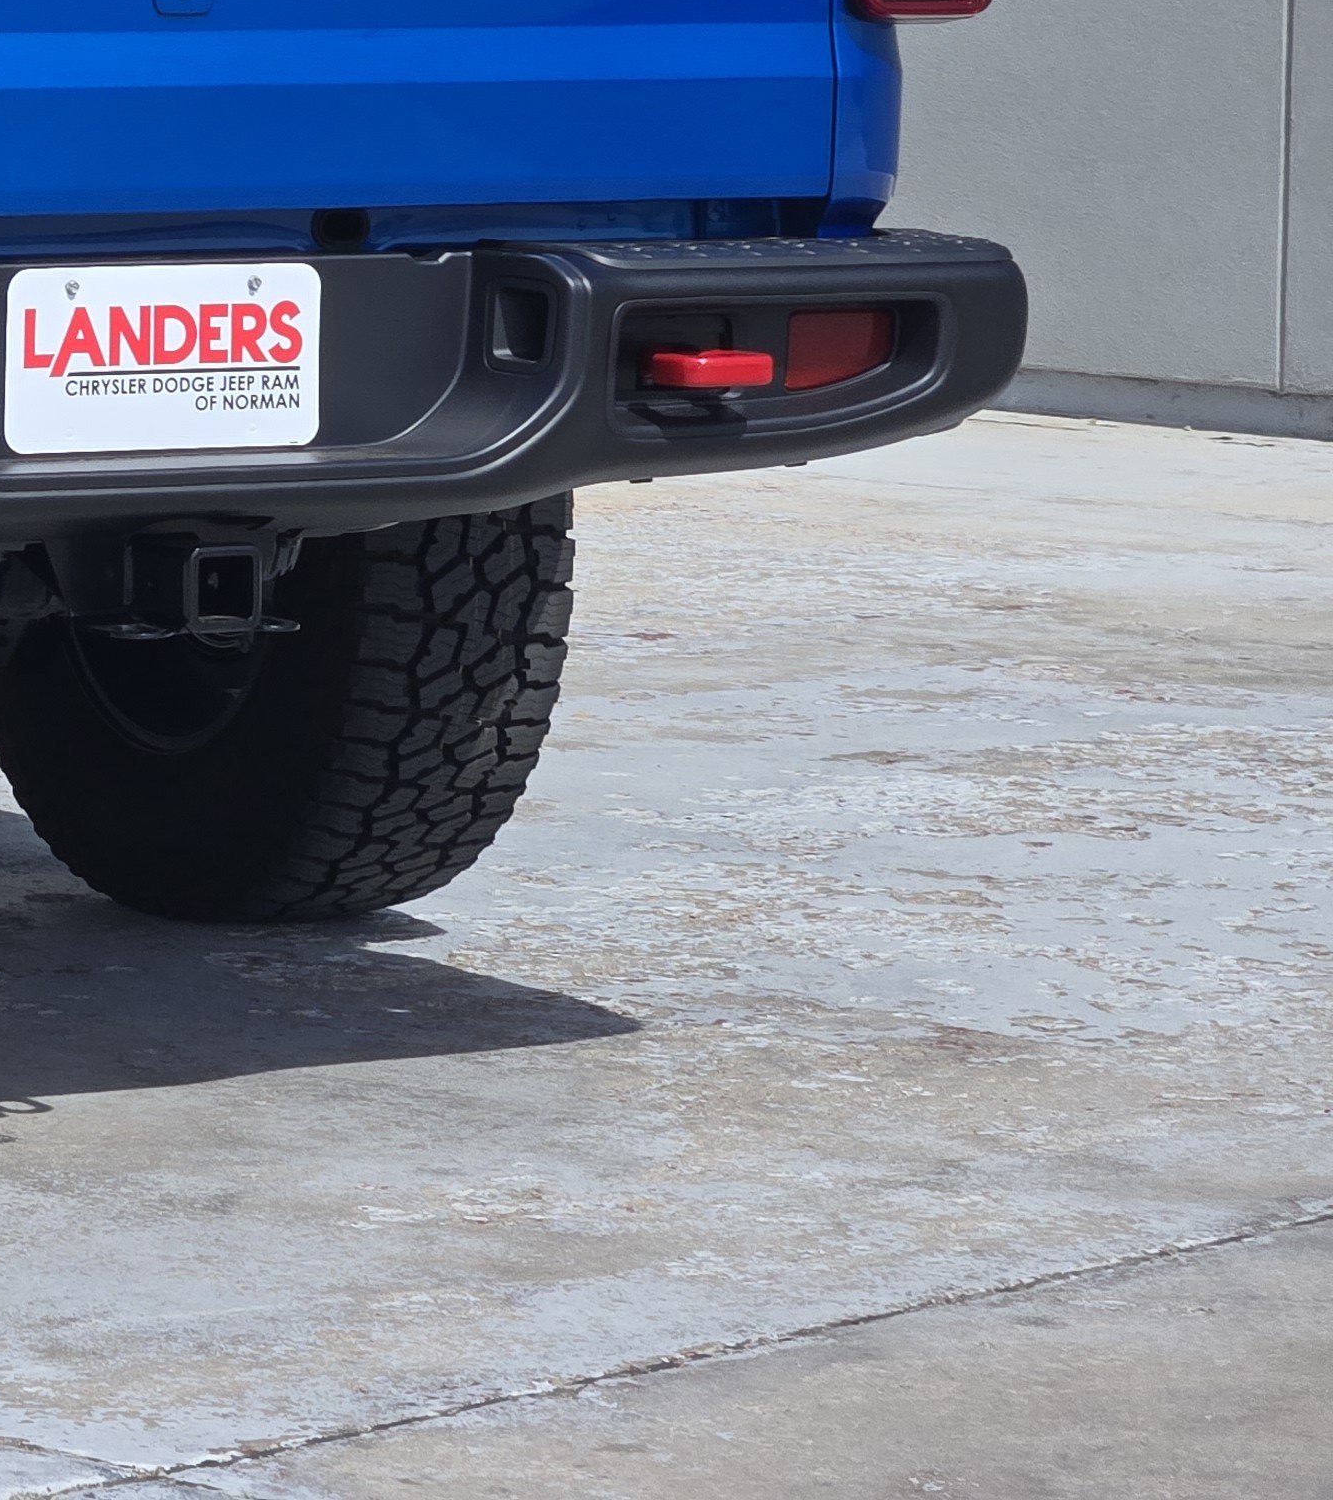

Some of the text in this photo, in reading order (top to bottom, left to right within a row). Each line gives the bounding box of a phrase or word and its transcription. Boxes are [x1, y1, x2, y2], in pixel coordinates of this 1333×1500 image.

[23, 300, 303, 378] LANDERS
[65, 373, 300, 397] CHRYSLER DODGE JEEP RAM
[194, 393, 301, 412] OF NORMAN
